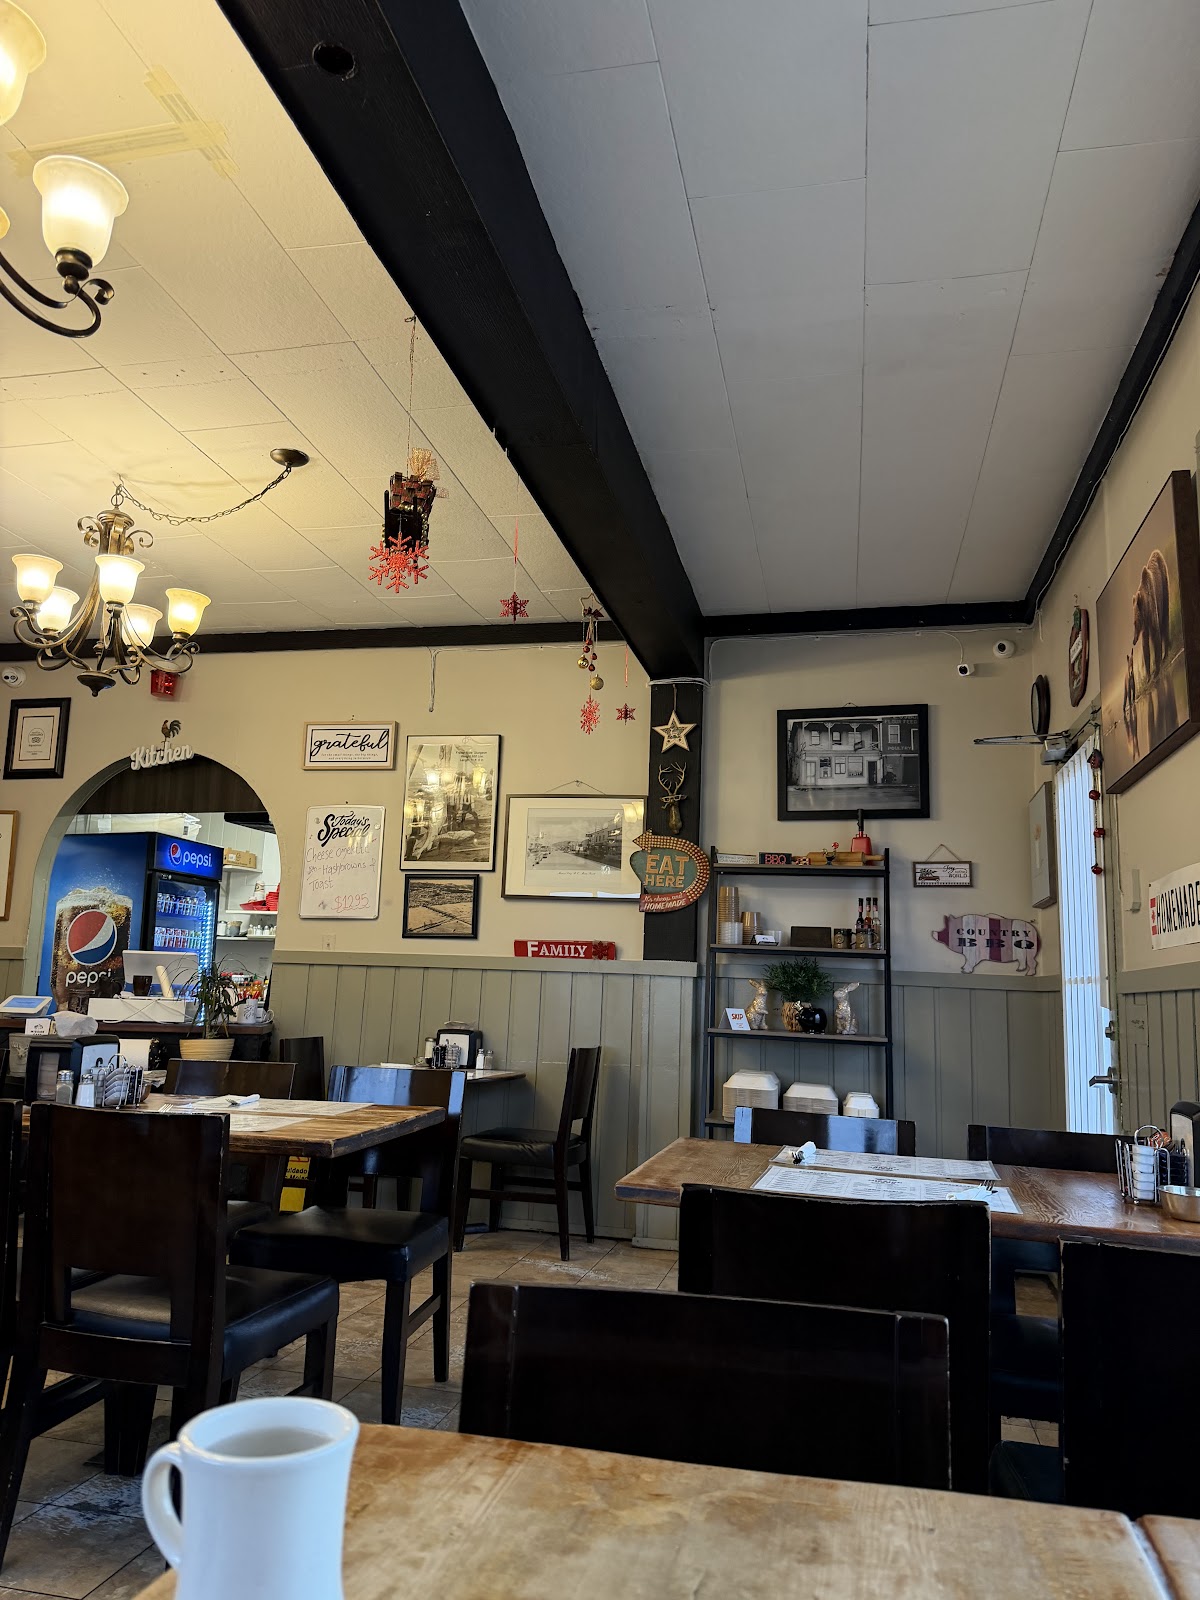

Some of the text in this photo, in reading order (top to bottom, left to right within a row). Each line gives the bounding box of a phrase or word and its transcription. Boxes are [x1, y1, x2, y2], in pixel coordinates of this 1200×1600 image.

[311, 730, 389, 756] grateful
[130, 741, 194, 770] Kitchen
[331, 810, 370, 828] Today's
[317, 813, 371, 847] Special
[182, 851, 212, 868] pepsi
[306, 848, 334, 863] Cheese
[764, 854, 786, 865] BBQ
[645, 854, 689, 875] EAT
[309, 877, 334, 892] Toast
[643, 874, 685, 888] HERE
[643, 898, 687, 911] HOMEMADE
[1156, 880, 1200, 935] HOMEMADE
[956, 928, 1031, 938] COUNTRY
[957, 937, 1035, 949] BBQ
